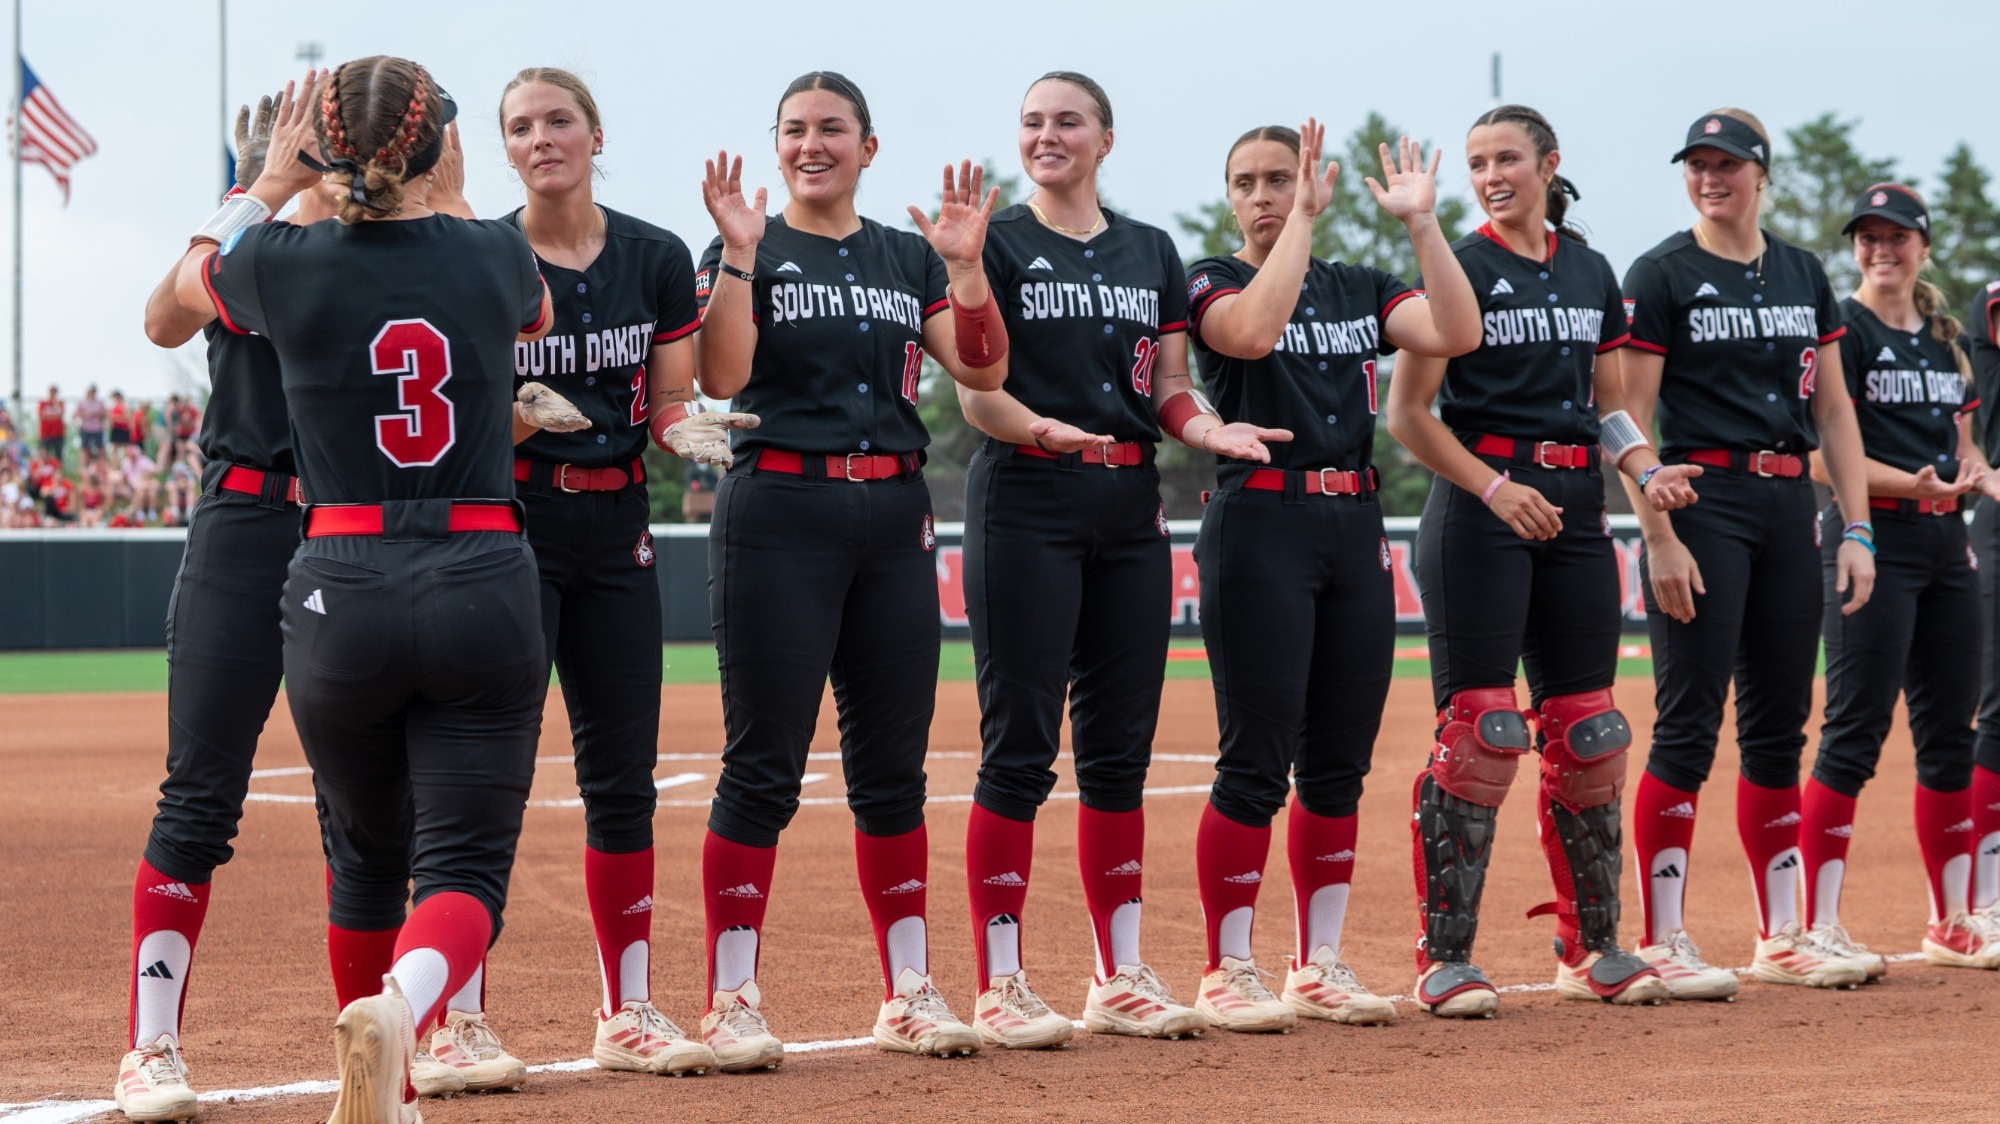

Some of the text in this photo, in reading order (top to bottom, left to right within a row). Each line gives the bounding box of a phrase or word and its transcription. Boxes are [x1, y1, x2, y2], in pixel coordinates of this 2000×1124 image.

[771, 283, 845, 322] SOUTH
[1021, 282, 1094, 320] SOUTH
[1484, 307, 1605, 346] SOUTH DAKOT
[1688, 307, 1757, 343] SOUTH
[514, 319, 657, 377] OUTH DAKOT
[369, 317, 457, 469] 3
[1865, 370, 1925, 403] SOUTH
[147, 887, 199, 903] adidas
[719, 890, 764, 899] adidas
[983, 878, 1026, 887] adidas
